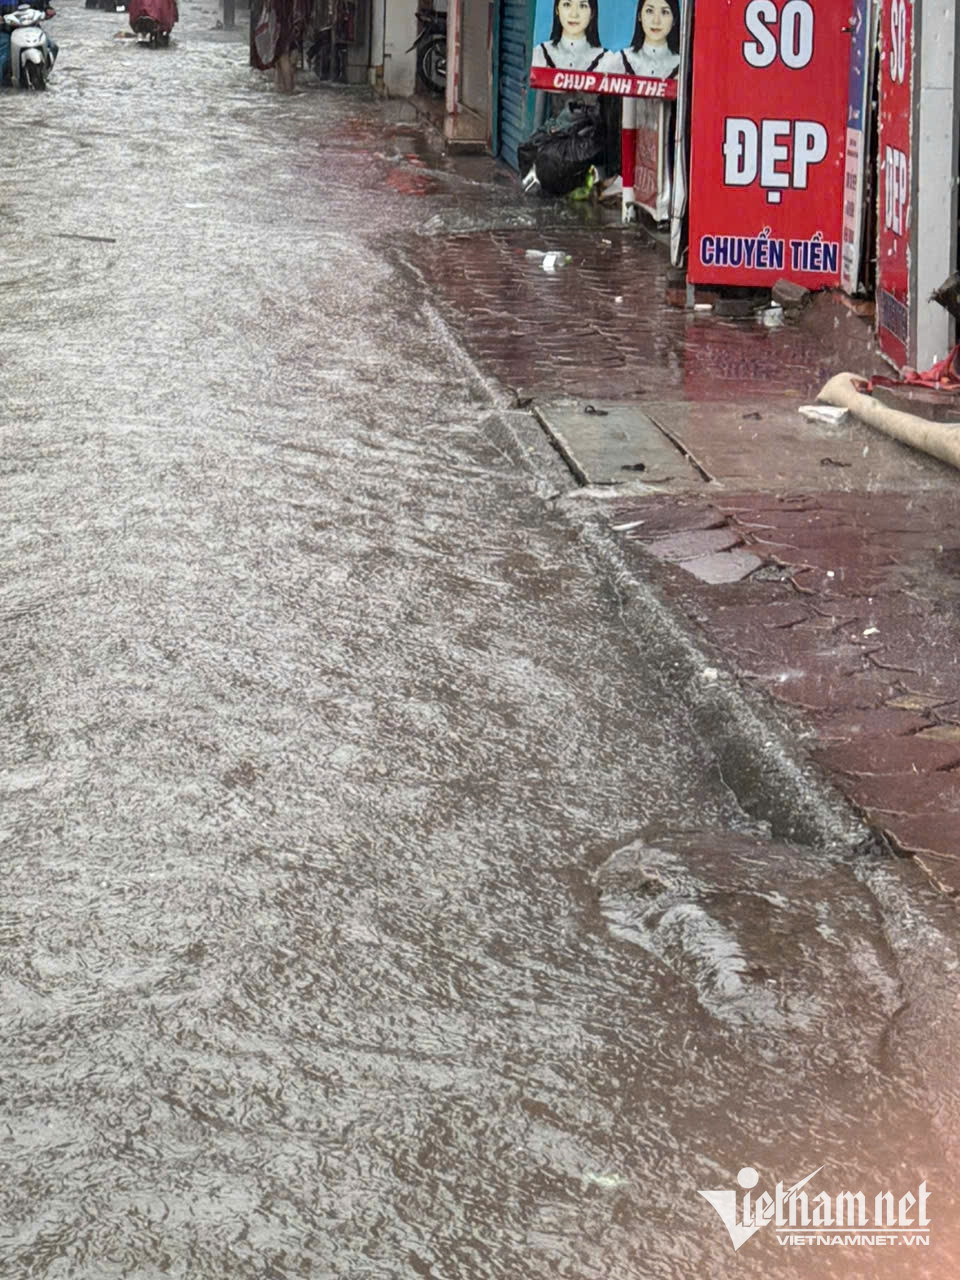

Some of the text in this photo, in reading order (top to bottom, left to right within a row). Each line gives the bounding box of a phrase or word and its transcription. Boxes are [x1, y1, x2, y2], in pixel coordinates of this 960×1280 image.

[598, 72, 632, 94] ẢNH
[723, 116, 829, 205] ĐẸP
[884, 144, 908, 257] ĐẸP
[700, 226, 839, 274] CHUYỂN TIỀN
